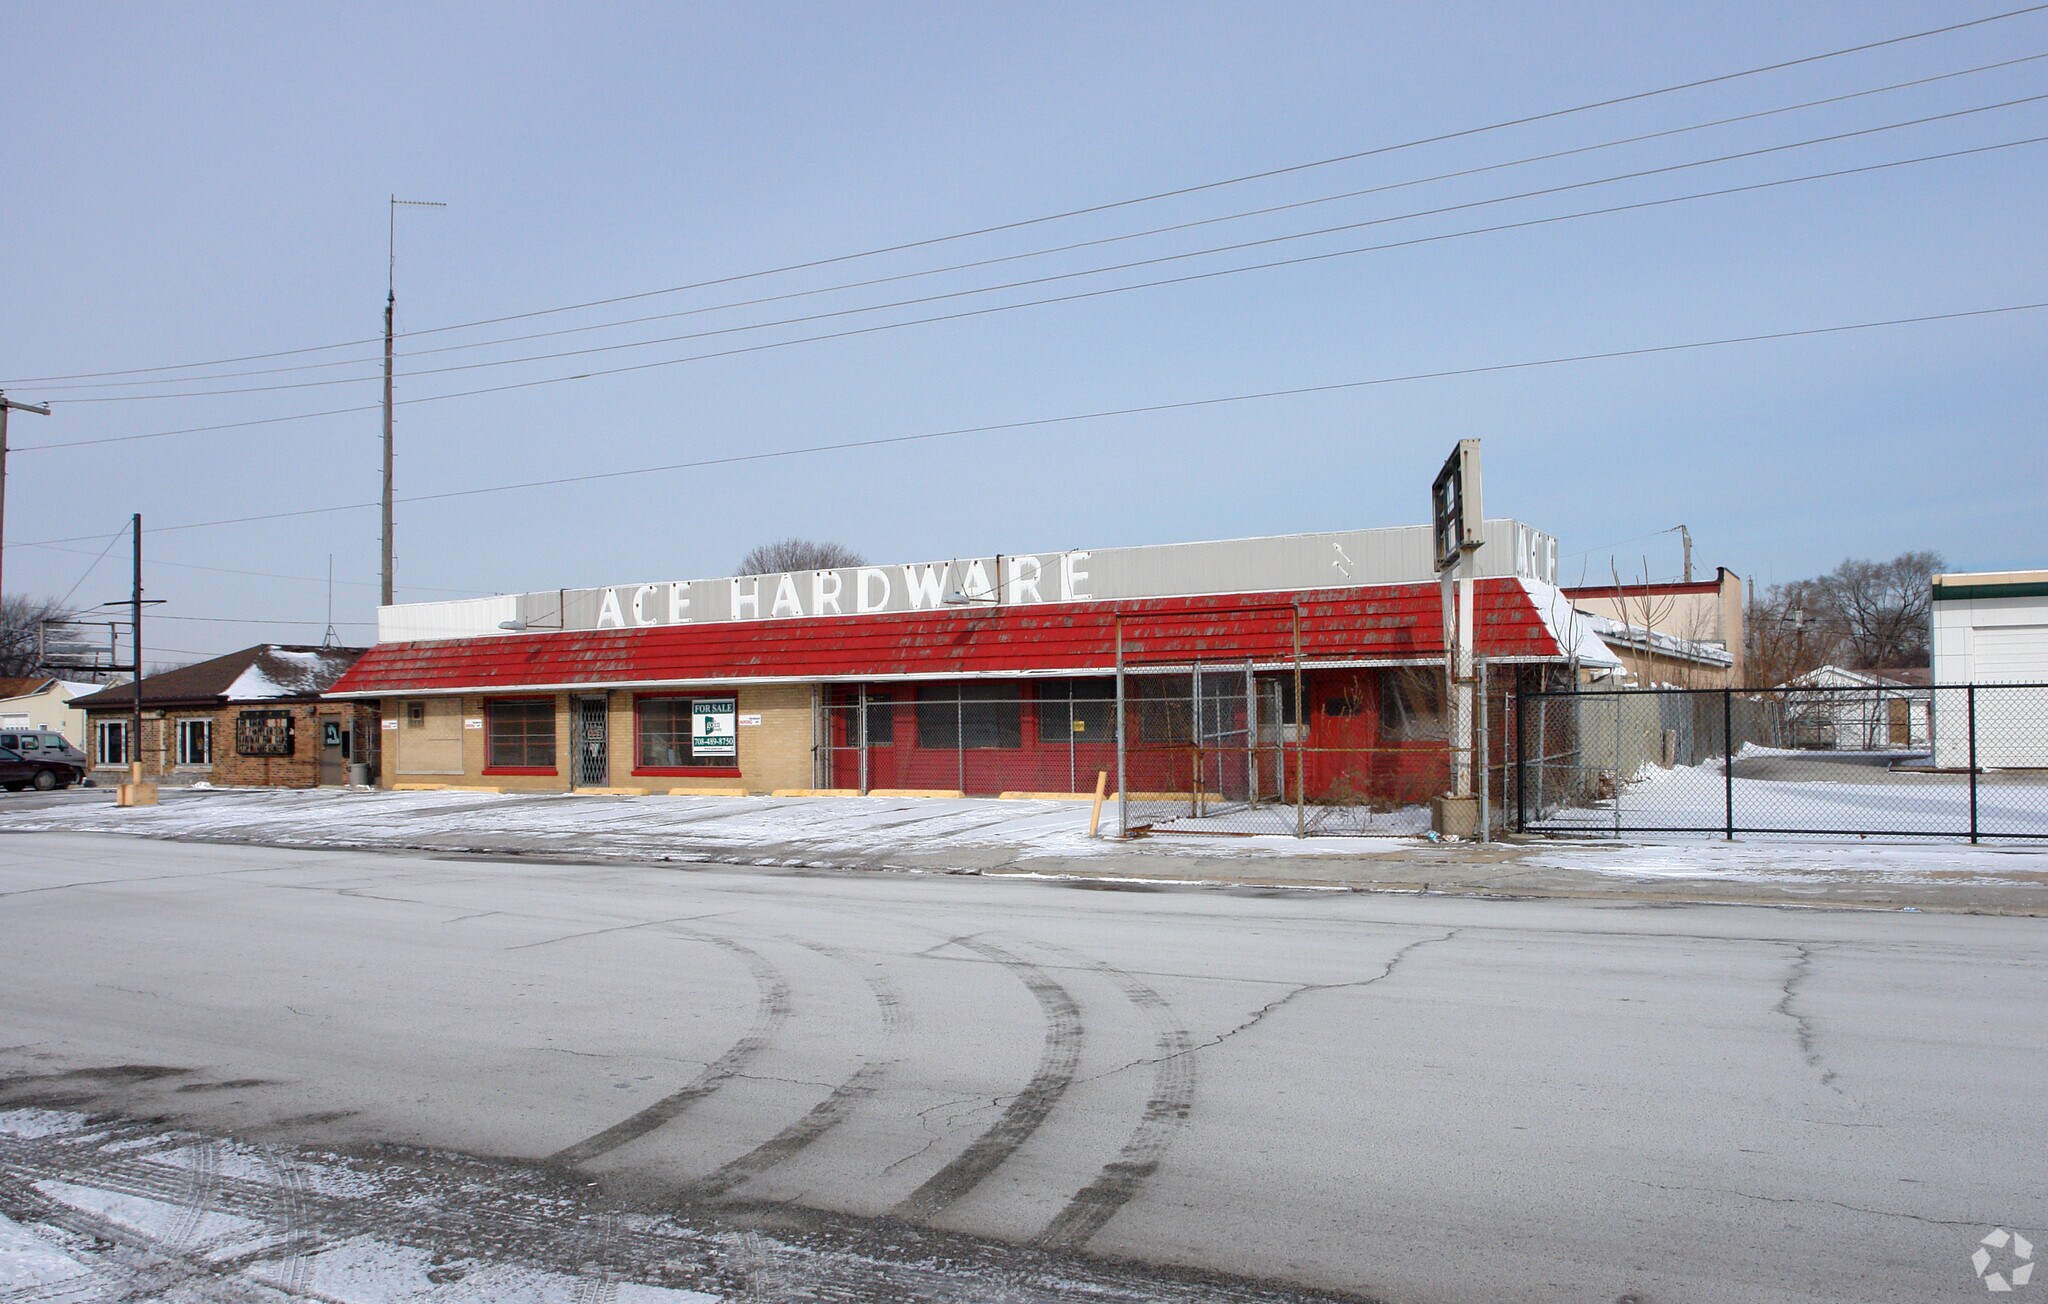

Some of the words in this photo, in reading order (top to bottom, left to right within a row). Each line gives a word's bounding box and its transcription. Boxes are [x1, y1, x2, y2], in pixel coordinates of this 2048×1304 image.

[597, 581, 692, 629] ACE
[731, 552, 1092, 620] HARDWARE
[695, 704, 711, 713] FOR
[712, 703, 732, 712] SALE
[695, 737, 733, 746] 708-489-8750
